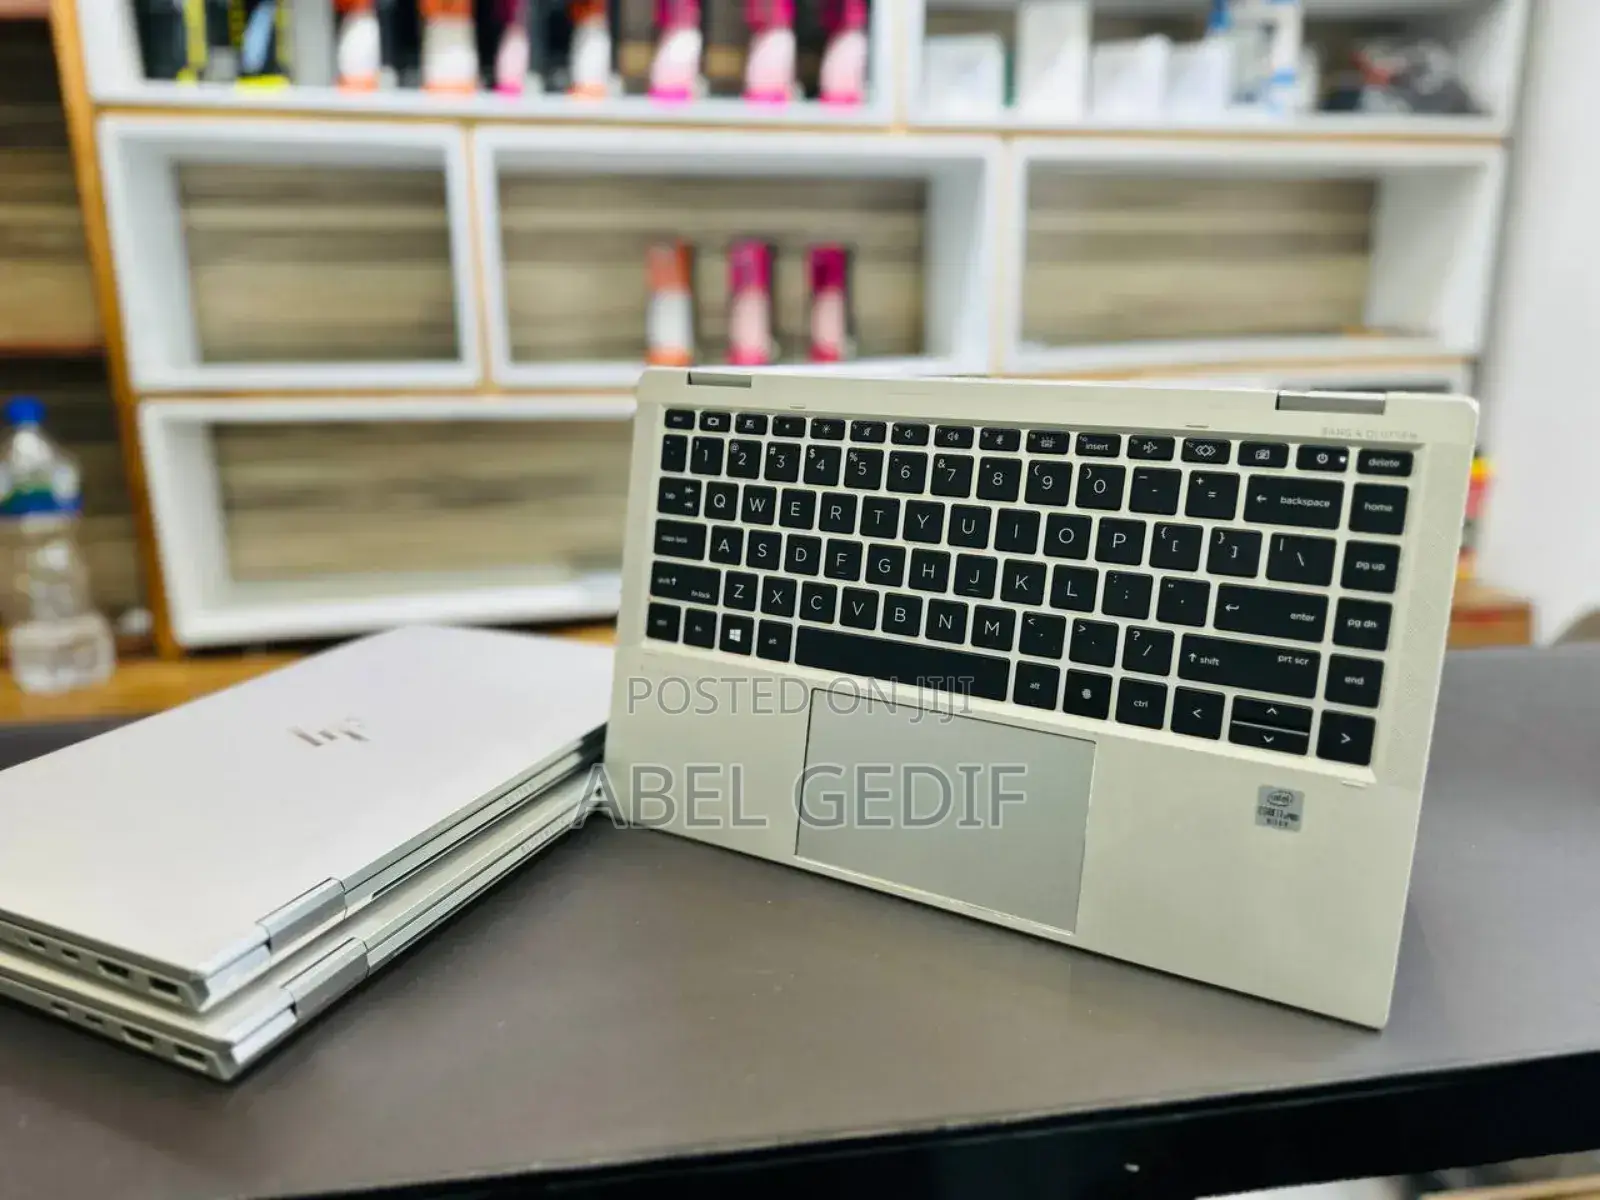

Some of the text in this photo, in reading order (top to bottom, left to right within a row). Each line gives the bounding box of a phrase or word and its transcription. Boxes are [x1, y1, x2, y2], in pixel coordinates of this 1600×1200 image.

[730, 443, 740, 453] @
[768, 446, 777, 456] #
[808, 448, 816, 459] $
[1085, 443, 1109, 451] insert
[703, 449, 709, 463] 1
[738, 452, 747, 466] 2
[775, 454, 786, 469] 3
[849, 451, 858, 462] %
[937, 458, 946, 469] &
[1367, 457, 1401, 468] delete
[815, 459, 825, 472] 4
[857, 461, 867, 476] 5
[900, 464, 911, 479] 6
[1033, 463, 1041, 476] (
[946, 467, 957, 482] 7
[991, 471, 1004, 486] 8
[1085, 467, 1093, 480] )
[1195, 476, 1205, 486] +
[1041, 475, 1054, 491] 9
[713, 493, 726, 509] Q
[1207, 490, 1217, 498] =
[749, 496, 766, 513] W
[790, 501, 801, 517] E
[1279, 495, 1331, 509] backspace
[1363, 501, 1394, 513] home
[829, 504, 842, 521] R
[873, 509, 885, 525] T
[916, 513, 930, 530] Y
[961, 517, 976, 535] U
[1058, 527, 1075, 545] O
[1160, 523, 1168, 540] {
[1217, 531, 1226, 545] }
[717, 538, 731, 553] A
[1111, 532, 1127, 549] P
[1171, 539, 1180, 553] [
[756, 542, 768, 558] S
[794, 546, 808, 563] D
[1230, 545, 1239, 559] ]
[835, 552, 848, 567] F
[877, 557, 891, 574] G
[1296, 551, 1305, 567] \
[1355, 560, 1386, 573] pg up
[921, 562, 936, 579] H
[969, 569, 980, 585] J
[1014, 573, 1029, 591] K
[1066, 579, 1078, 598] L
[733, 583, 745, 599] Z
[770, 589, 783, 605] X
[810, 593, 823, 611] C
[851, 600, 865, 616] V
[894, 606, 906, 623] B
[938, 613, 953, 630] N
[1027, 617, 1036, 626] <
[1289, 612, 1317, 622] enter
[984, 619, 1000, 637] M
[1077, 624, 1087, 633] >
[1346, 618, 1379, 629] pg dn
[1132, 630, 1141, 641] ?
[1141, 644, 1153, 657] /
[1200, 654, 1220, 667] shift
[1277, 653, 1310, 667] prt scr
[1029, 682, 1041, 690] alt
[1343, 675, 1365, 686] end
[1133, 699, 1149, 708] ctrl
